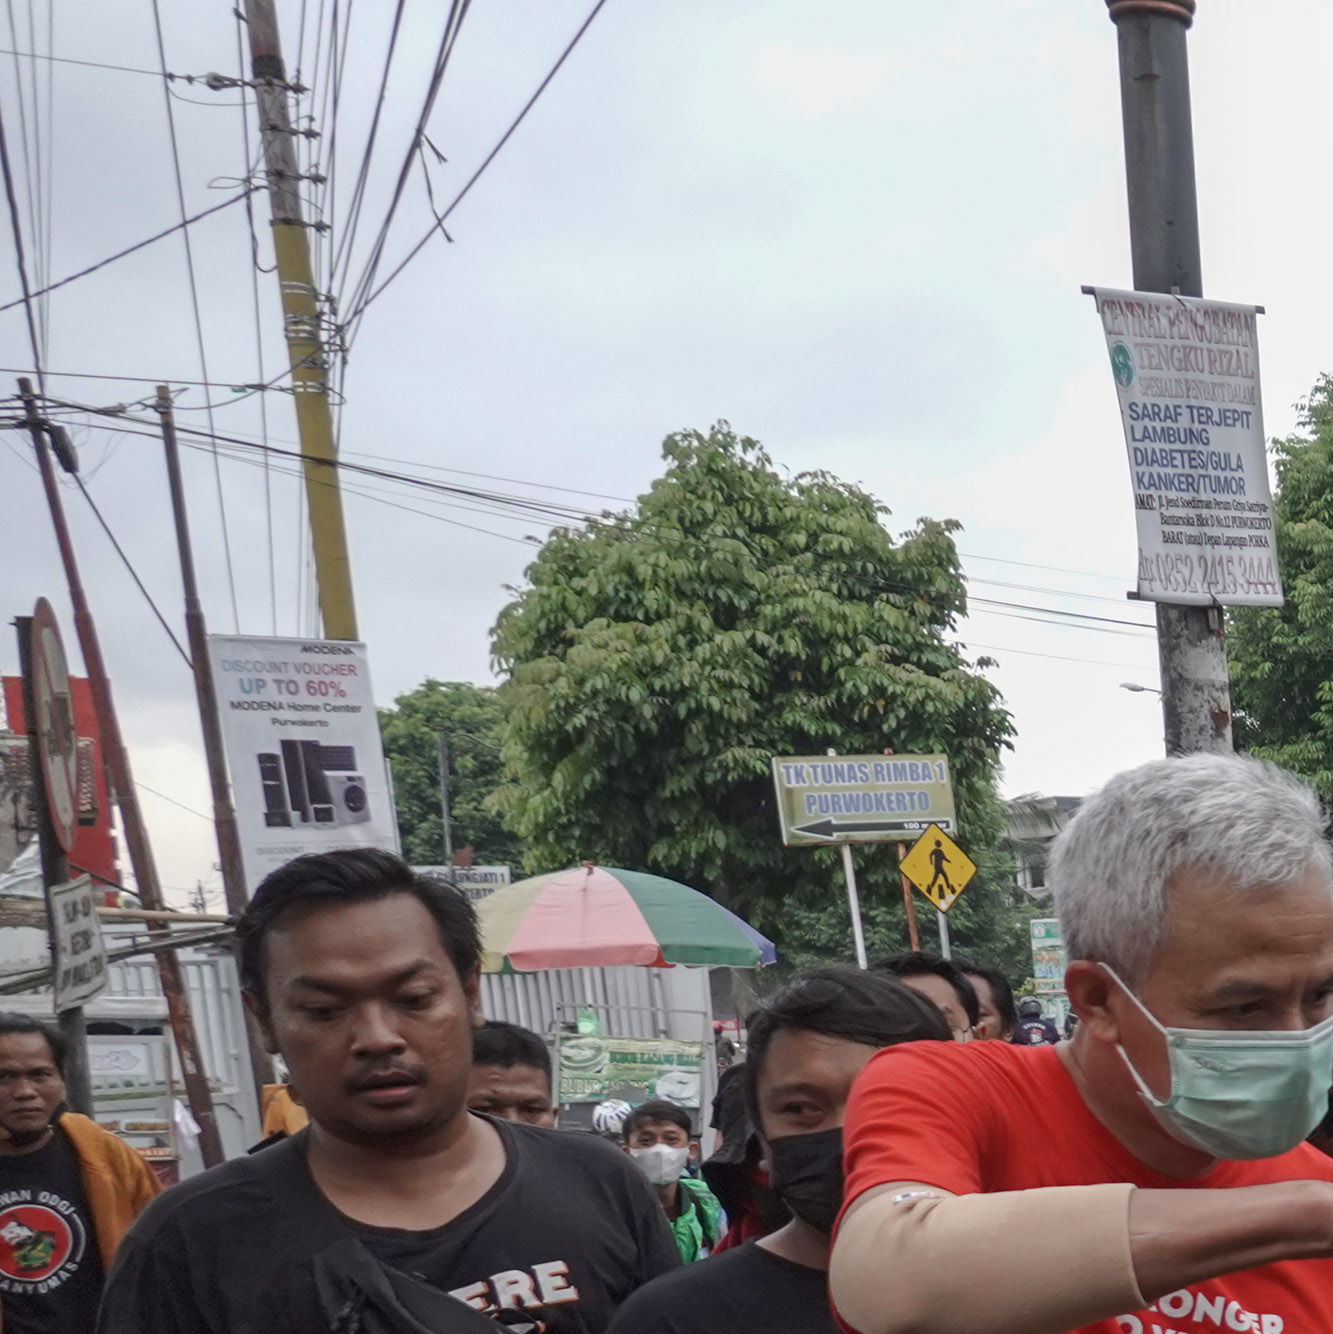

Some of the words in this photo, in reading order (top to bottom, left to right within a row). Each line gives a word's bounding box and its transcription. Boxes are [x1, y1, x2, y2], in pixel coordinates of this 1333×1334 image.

[1134, 342, 1205, 373] TENGKU
[1208, 348, 1255, 379] RIZAL
[1128, 402, 1183, 424] SARAF
[1185, 405, 1252, 430] TERJEPIT
[1130, 424, 1210, 446] LAMBUNG
[1133, 447, 1245, 472] DIABETES/GULA
[1136, 471, 1247, 496] KANKER/TUMOR
[1231, 516, 1272, 531] PURWOKERTO
[1162, 530, 1184, 544] BARAT
[1239, 555, 1279, 595] 3444
[301, 645, 356, 655] MODENA
[221, 659, 290, 674] DISCOUNT
[293, 662, 358, 677] VOUCHER
[239, 678, 267, 695] UP
[272, 679, 299, 696] TO
[306, 680, 347, 698] 60%
[230, 701, 286, 712] MODENA
[287, 702, 321, 713] Home
[323, 703, 362, 713] Center
[270, 717, 330, 728] Purwokerto
[782, 763, 807, 785] TK
[809, 763, 870, 784] TUNAS
[873, 761, 933, 783] RIMBA
[935, 761, 945, 781] 1
[805, 791, 930, 814] PURWOKERTO
